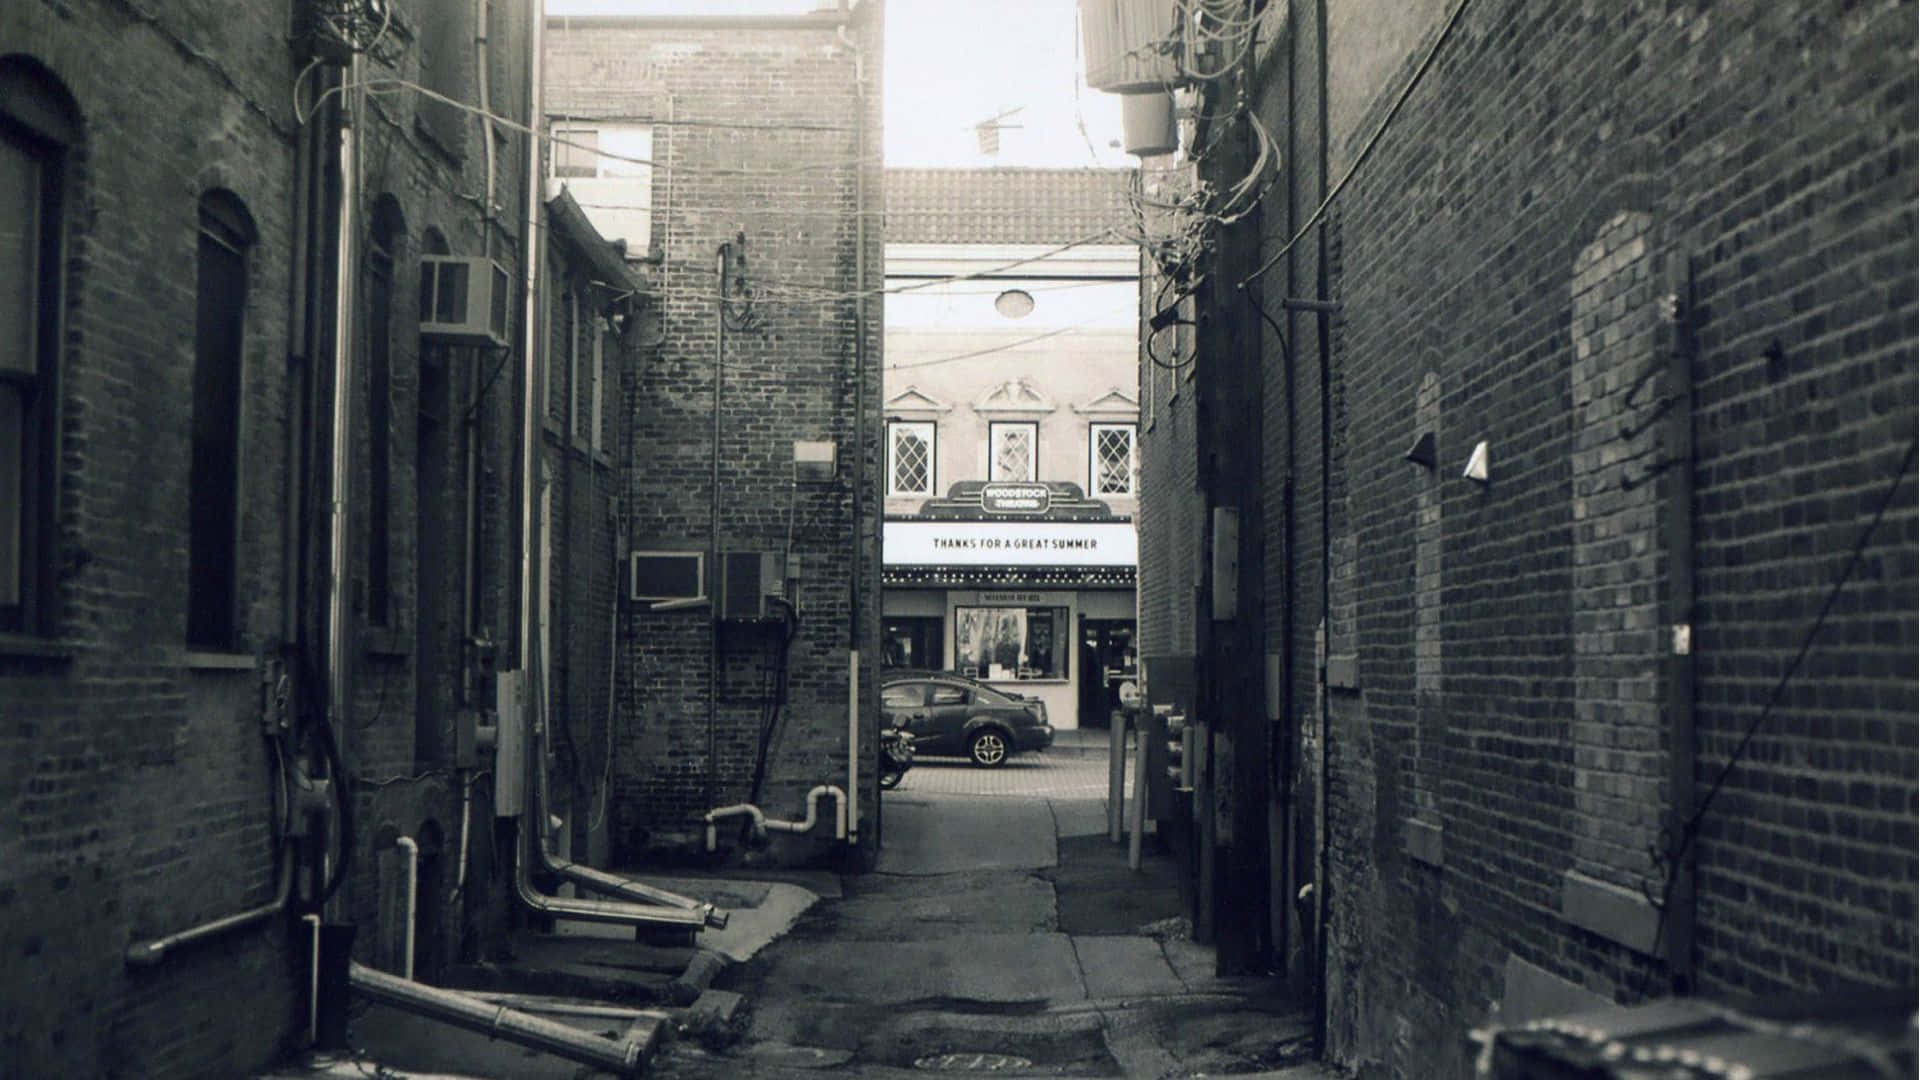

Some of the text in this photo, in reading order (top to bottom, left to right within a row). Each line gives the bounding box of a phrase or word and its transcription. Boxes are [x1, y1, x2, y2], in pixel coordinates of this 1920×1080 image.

[986, 488, 1047, 498] WOODSTOCK
[933, 538, 1098, 549] THANKS FOR A GREAT SUMMER
